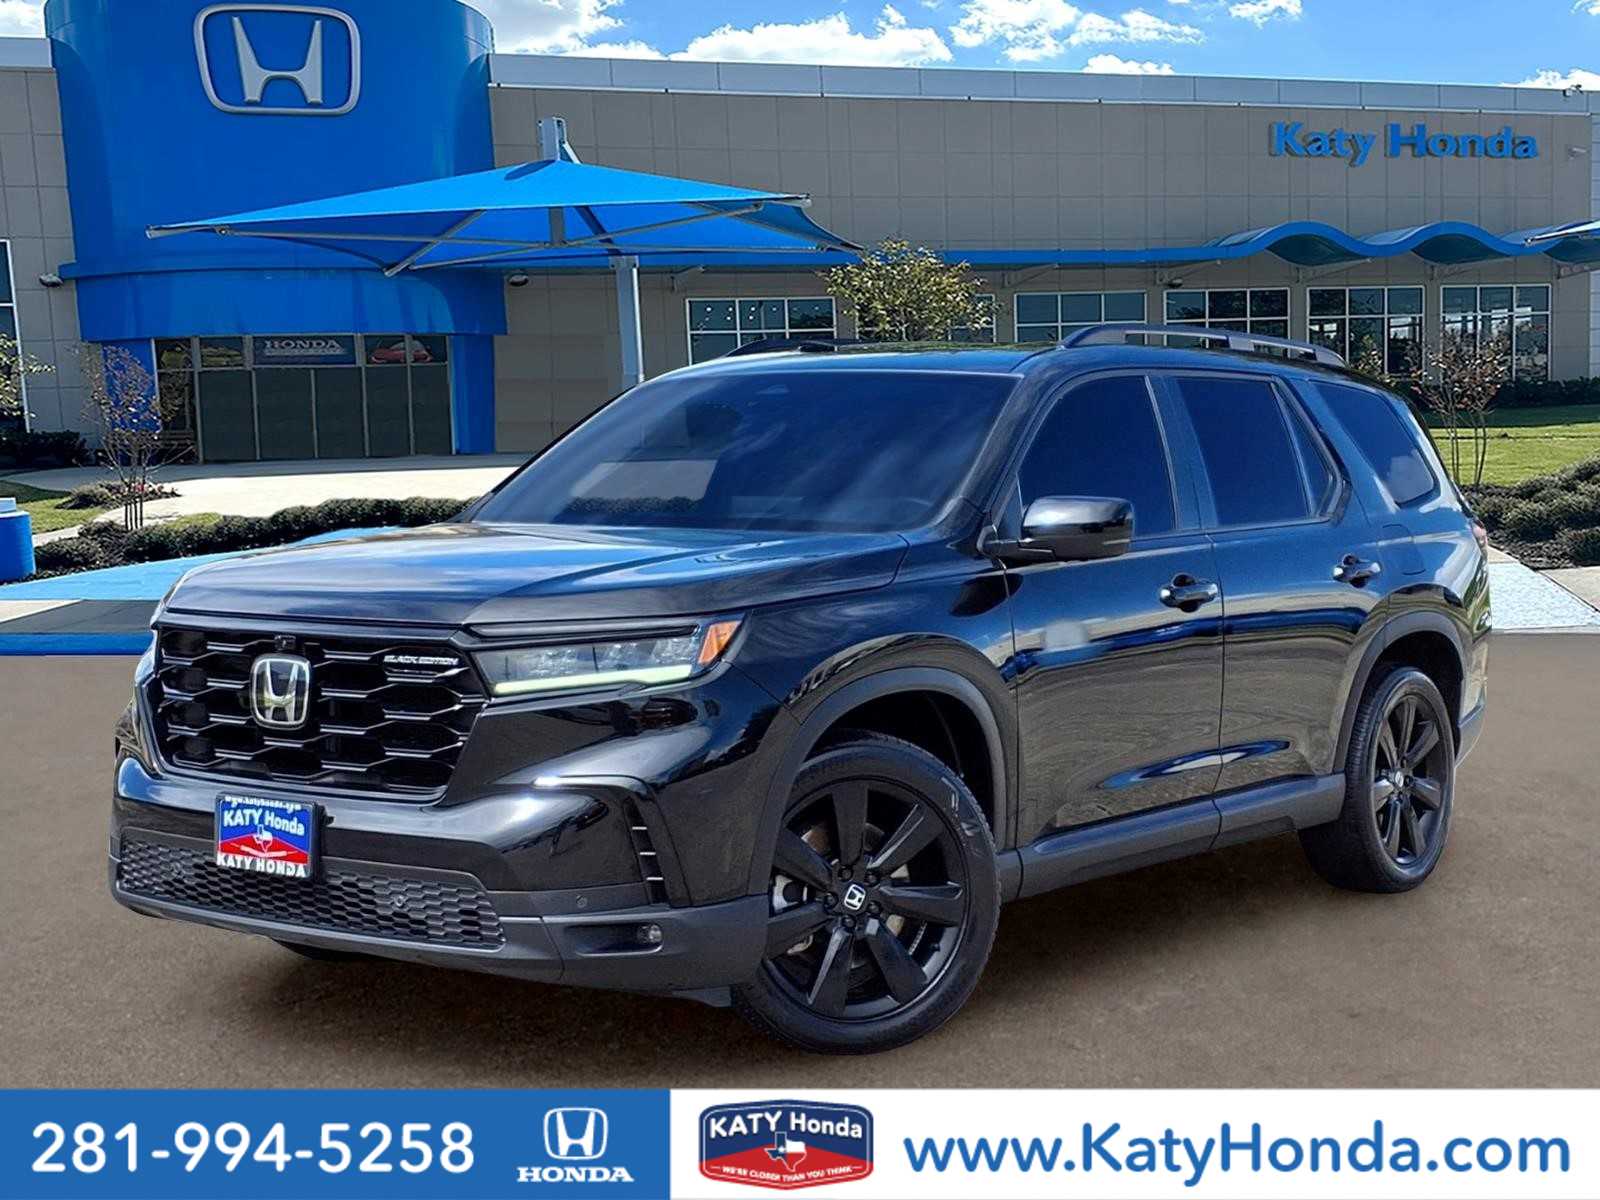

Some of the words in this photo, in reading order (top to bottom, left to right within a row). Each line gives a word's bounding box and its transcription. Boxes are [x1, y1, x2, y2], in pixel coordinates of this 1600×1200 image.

[1269, 121, 1376, 167] Katy
[1385, 123, 1539, 159] Honda
[264, 339, 342, 349] HONDA
[223, 808, 262, 827] KATY
[264, 810, 305, 836] Honda
[217, 853, 253, 870] KATY
[255, 859, 306, 878] HONDA
